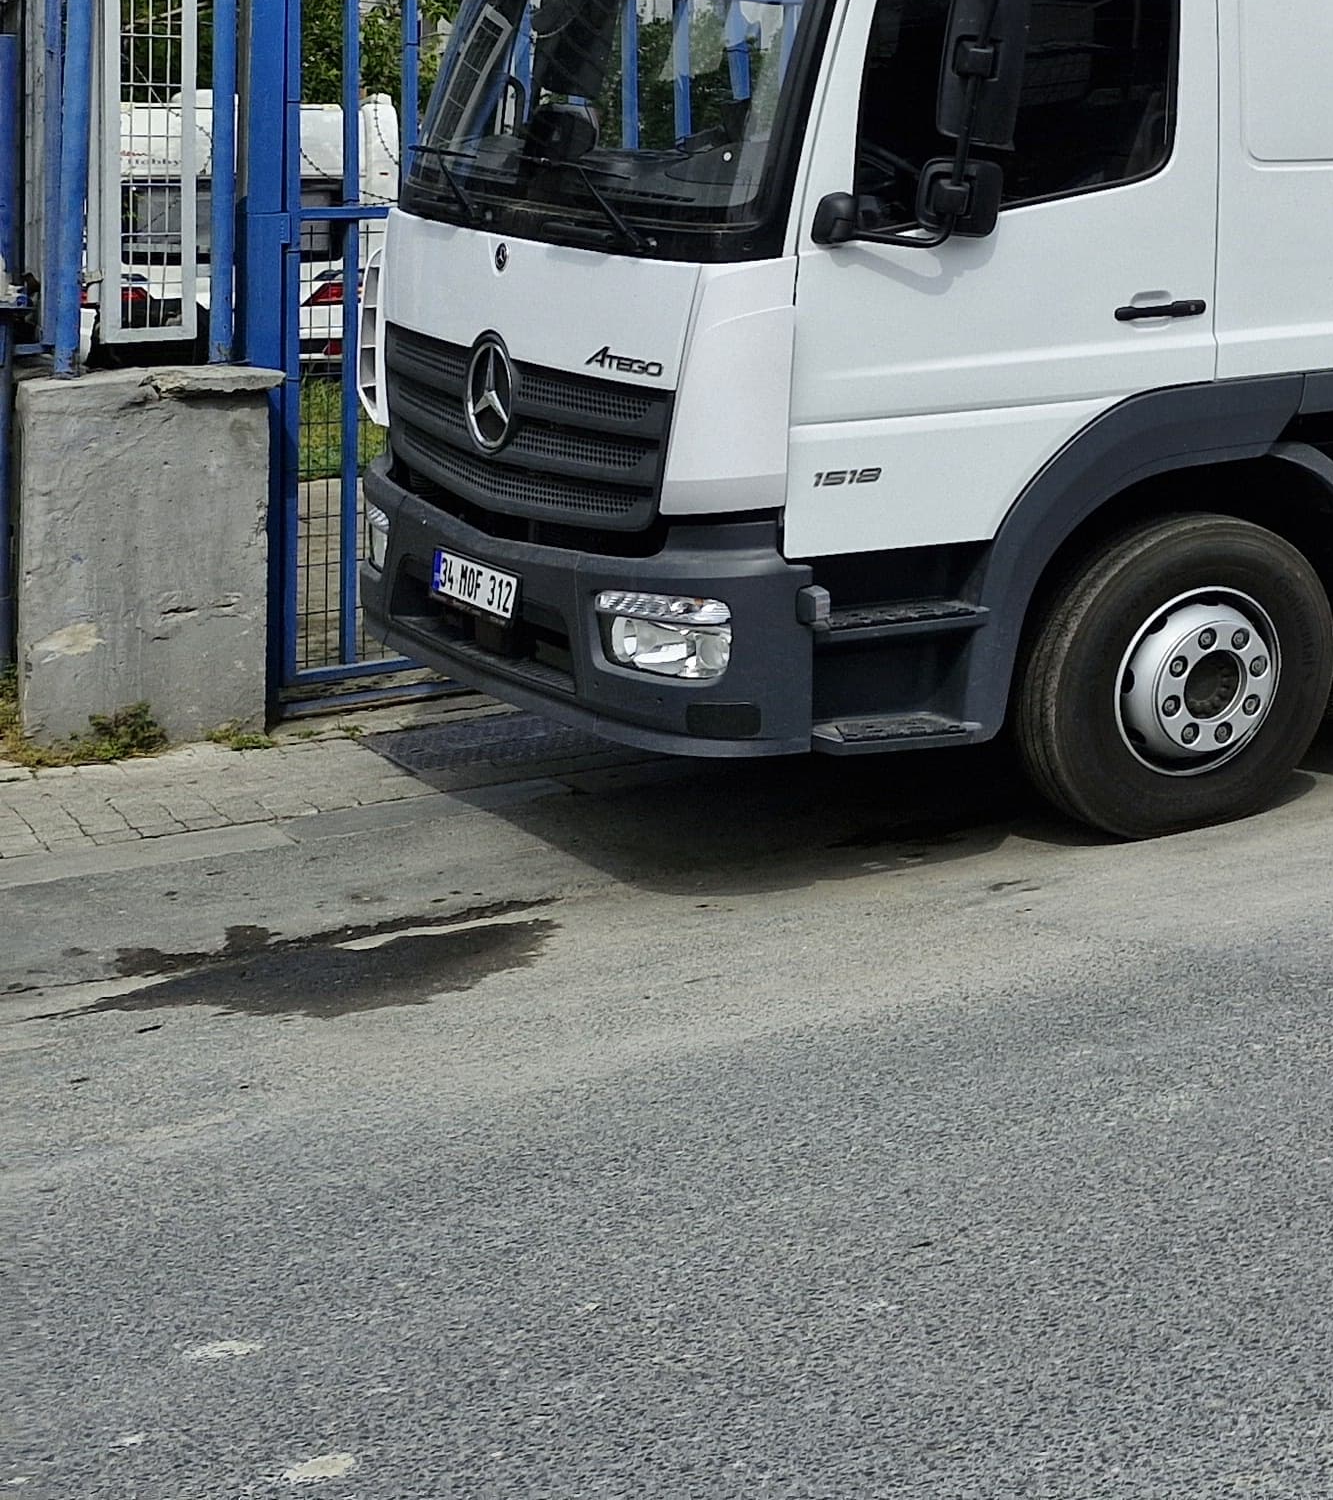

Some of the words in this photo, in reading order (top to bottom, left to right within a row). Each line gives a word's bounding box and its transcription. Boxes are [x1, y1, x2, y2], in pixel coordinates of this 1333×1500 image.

[813, 467, 882, 487] 1518
[440, 557, 454, 591] 34
[458, 563, 483, 601] MOF
[487, 574, 513, 614] 312
